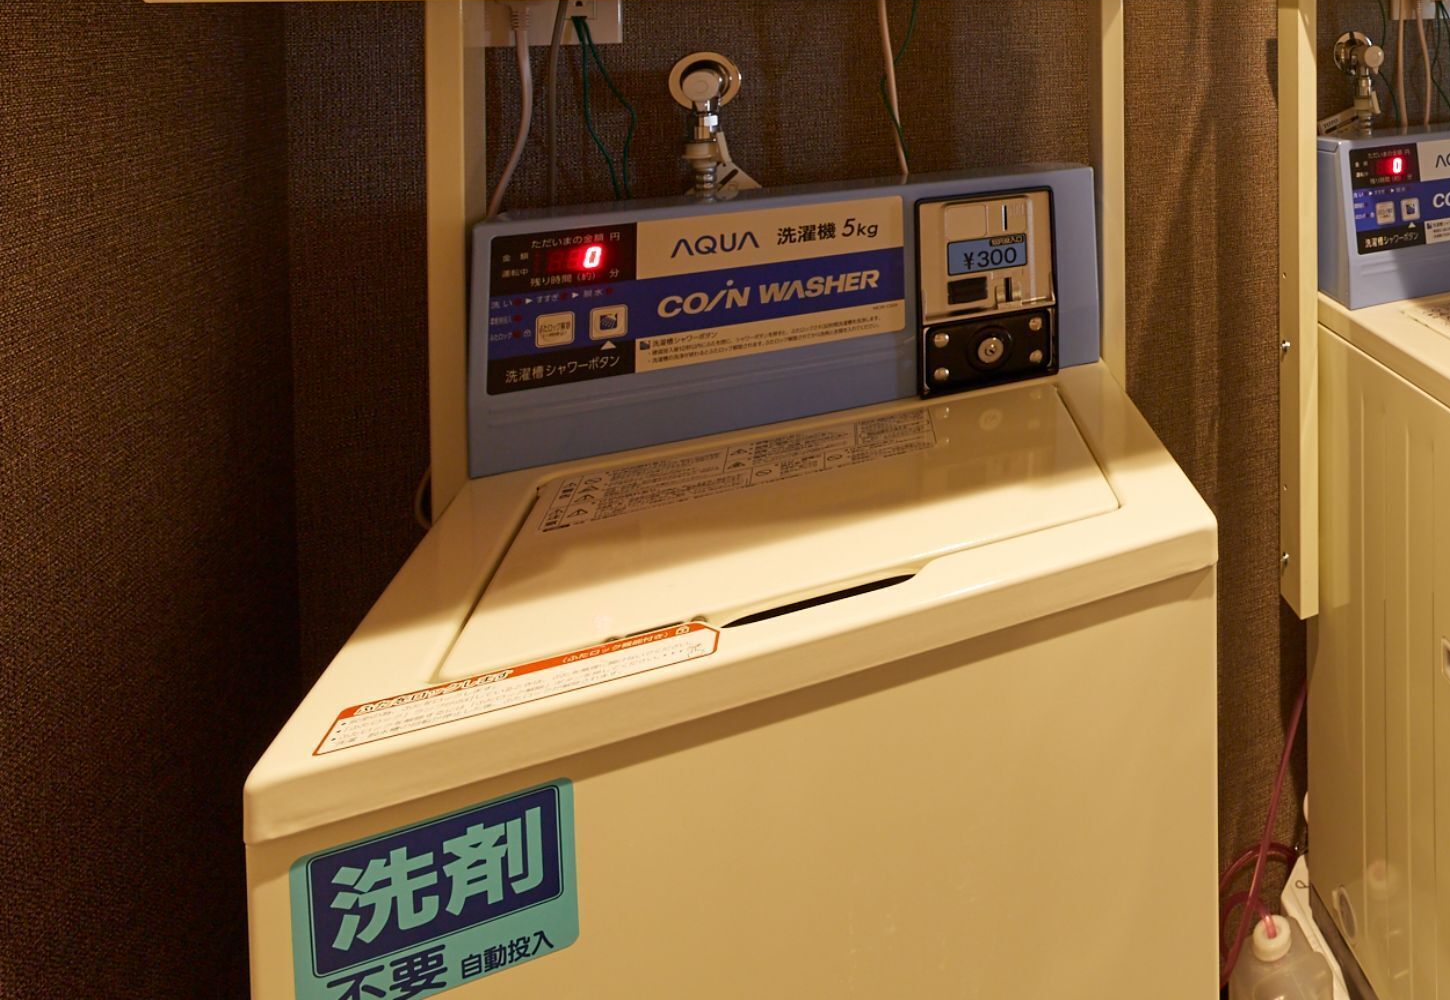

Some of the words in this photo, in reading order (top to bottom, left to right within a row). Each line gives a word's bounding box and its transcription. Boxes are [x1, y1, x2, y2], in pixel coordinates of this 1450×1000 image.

[1392, 157, 1402, 174] 0
[531, 232, 604, 249] ただいまの金額
[609, 231, 621, 241] 円
[670, 231, 760, 258] AQUA
[776, 222, 836, 245] 洗濯機
[841, 217, 878, 239] 5kg
[583, 246, 602, 269] 0
[963, 247, 1018, 270] ¥300
[609, 269, 620, 279] 分
[760, 268, 881, 304] WASHER
[505, 355, 620, 384] 洗濯槽シャワーボタン
[329, 805, 544, 952] 洗剤
[326, 943, 449, 1000] 不要
[460, 930, 555, 980] 自動投入
